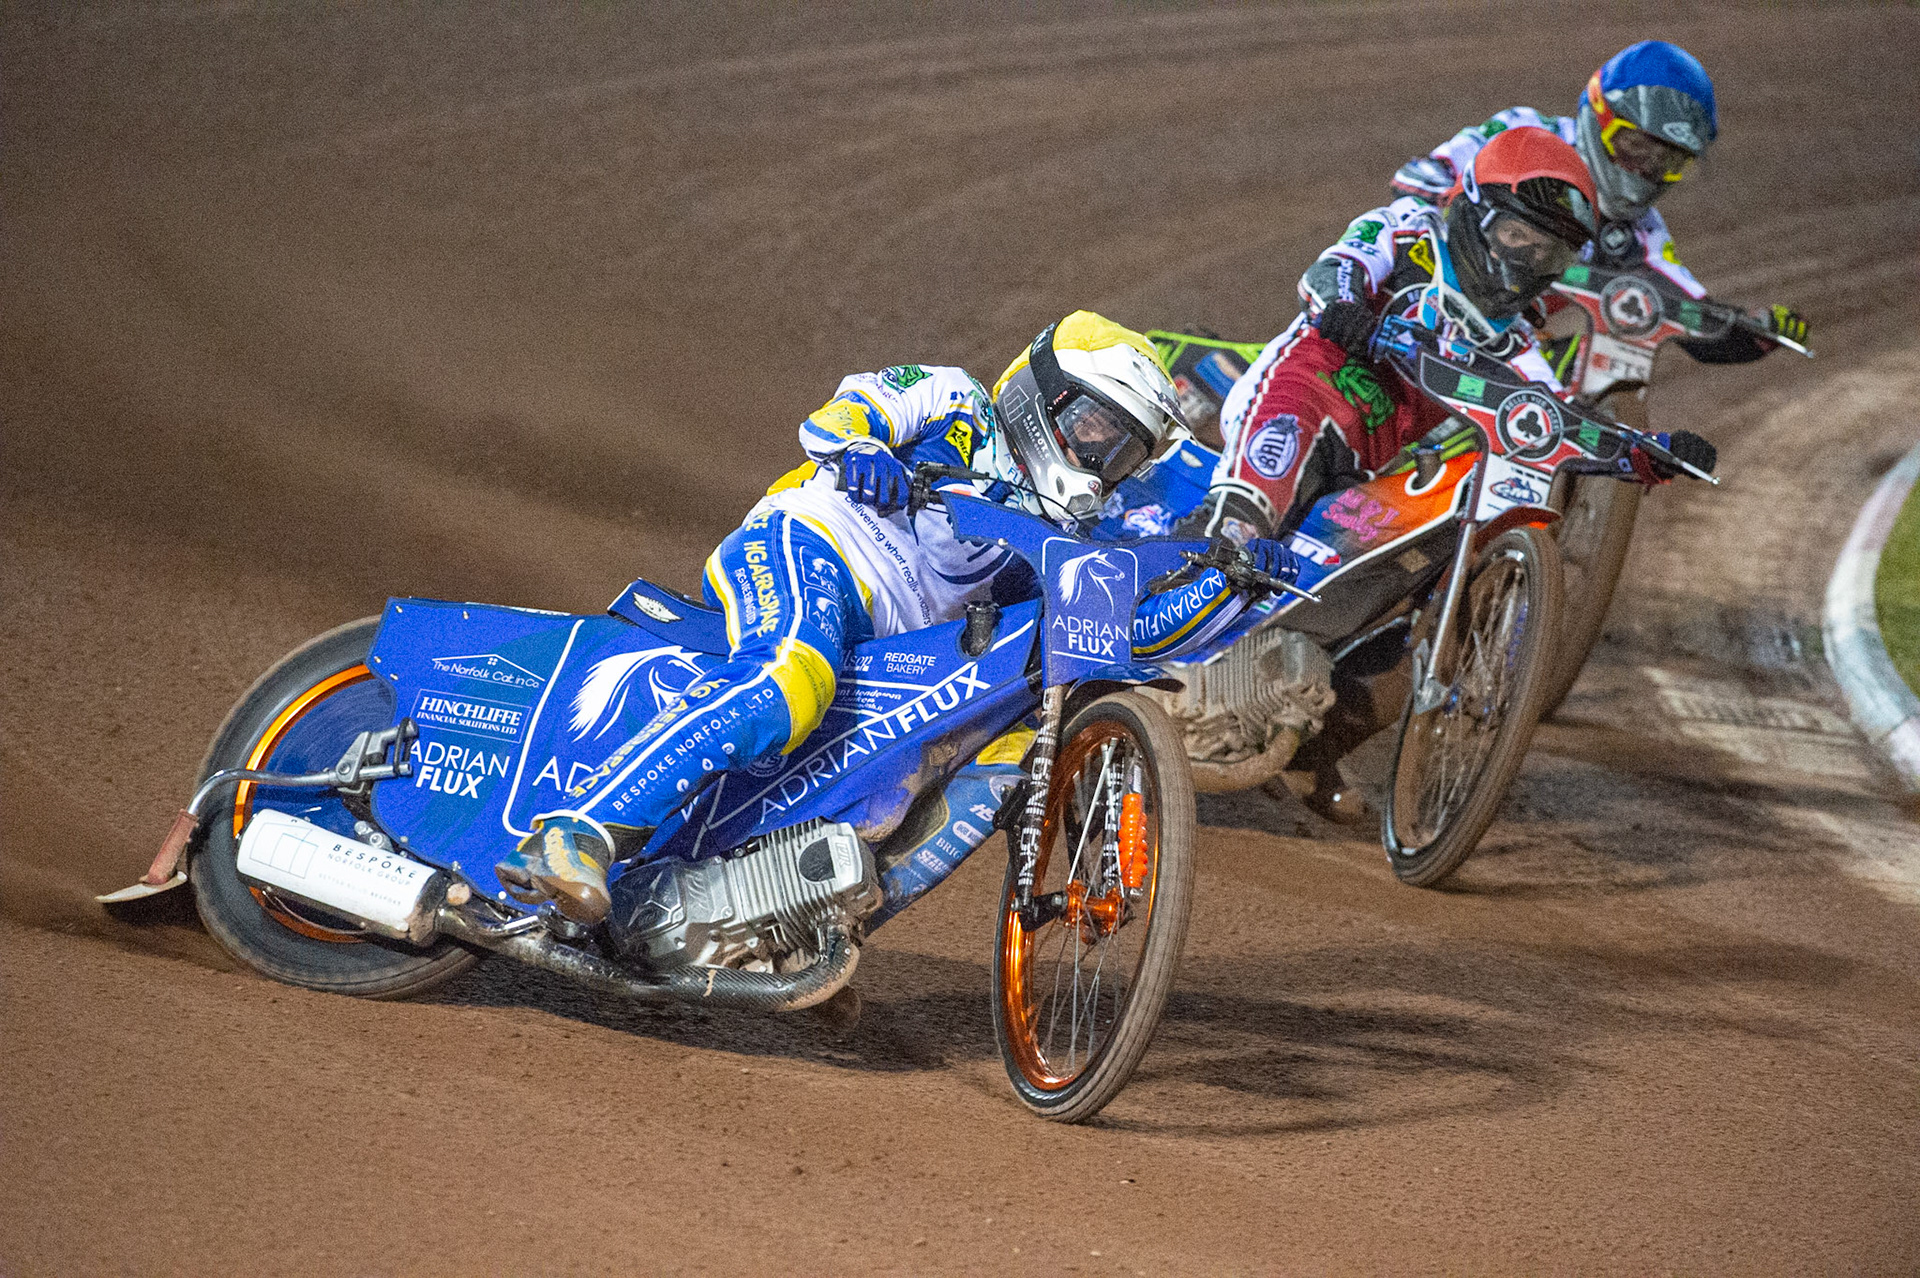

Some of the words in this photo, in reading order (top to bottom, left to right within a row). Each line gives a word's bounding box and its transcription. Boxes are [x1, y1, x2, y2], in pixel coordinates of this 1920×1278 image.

[884, 539, 907, 566] what
[1160, 570, 1224, 631] ADRIAN
[1052, 615, 1129, 641] ADRIAN
[884, 652, 936, 667] REDGATE
[1068, 634, 1115, 657] FLUX
[433, 660, 450, 673] The
[450, 663, 490, 679] Norfolk
[886, 663, 927, 675] BAKERY
[416, 711, 457, 724] FINANCIAL
[457, 717, 500, 733] SOLUTIONS
[501, 725, 517, 735] LTD
[420, 696, 523, 726] HINCHLIFFE
[410, 740, 510, 778] ADRIAN
[612, 755, 676, 812] BESPOKE
[675, 708, 741, 755] NORFOLK
[747, 687, 776, 711] LTD
[760, 719, 897, 824] ADRIAN
[898, 664, 991, 734] FLUX
[416, 766, 484, 799] FLUX
[327, 852, 373, 875] NORFOLK
[377, 866, 412, 887] GROUP
[332, 842, 417, 879] BESPOKE
